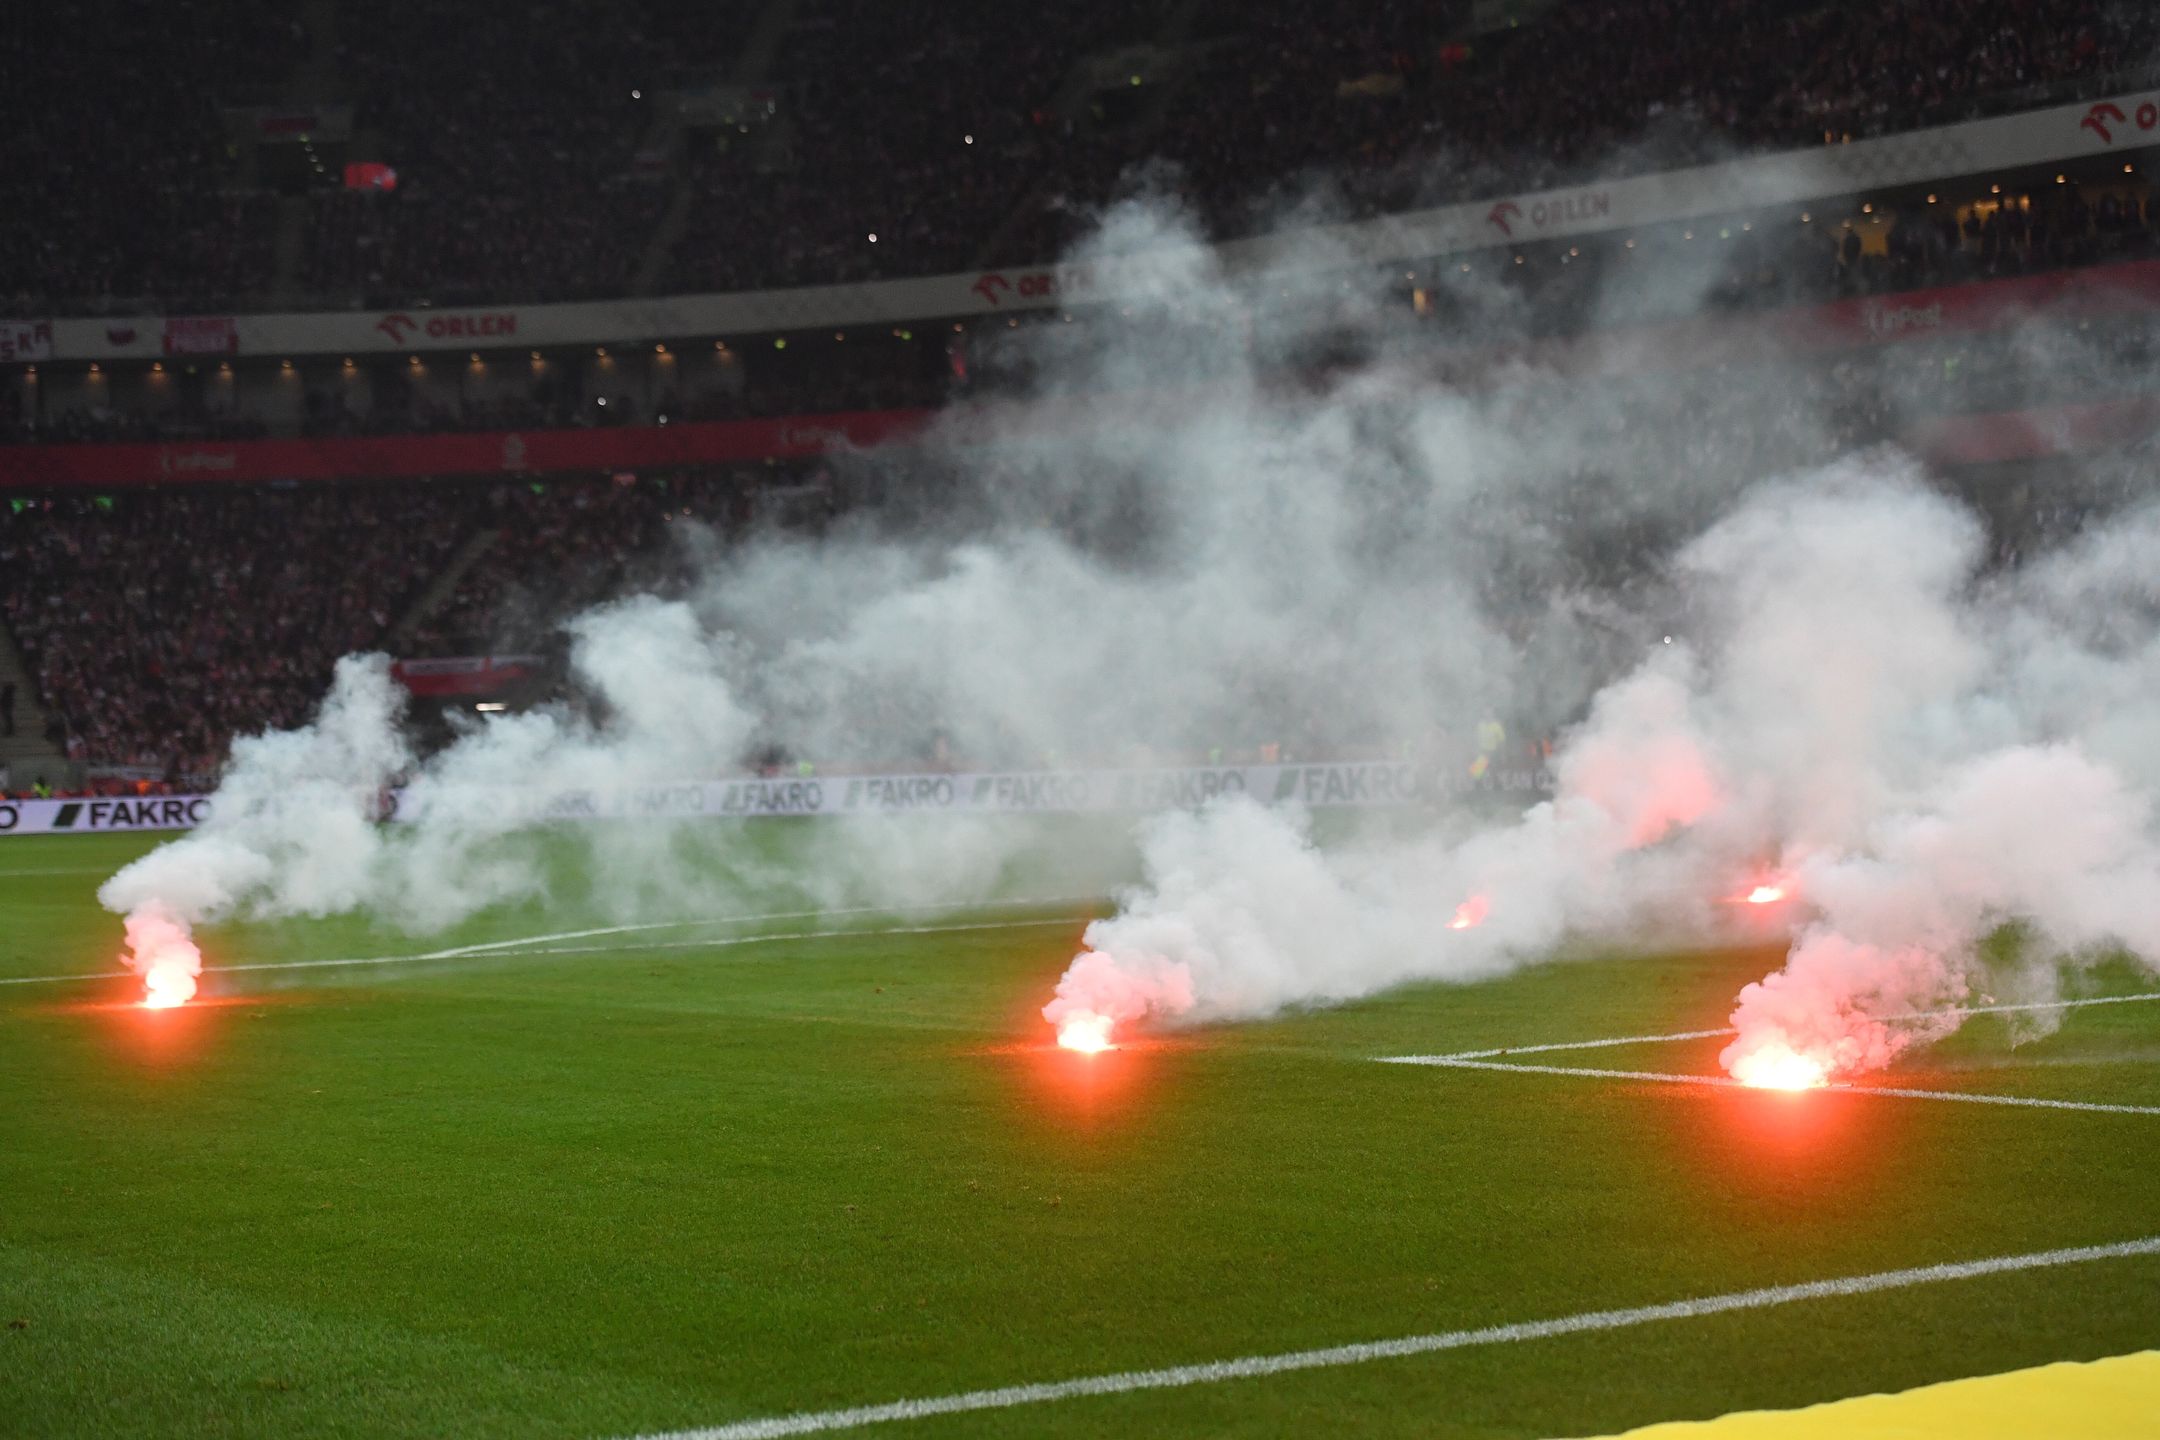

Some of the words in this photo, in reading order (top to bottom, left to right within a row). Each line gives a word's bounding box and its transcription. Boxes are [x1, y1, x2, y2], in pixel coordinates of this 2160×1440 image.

[1532, 192, 1609, 228] ORLEN
[425, 314, 517, 337] ORLEN
[743, 781, 823, 811] FAKRO
[866, 777, 955, 808] FAKRO
[996, 774, 1088, 807] FAKRO
[1140, 769, 1247, 806] FAKRO
[1304, 764, 1421, 803] FAKRO
[88, 800, 211, 827] FAKRO
